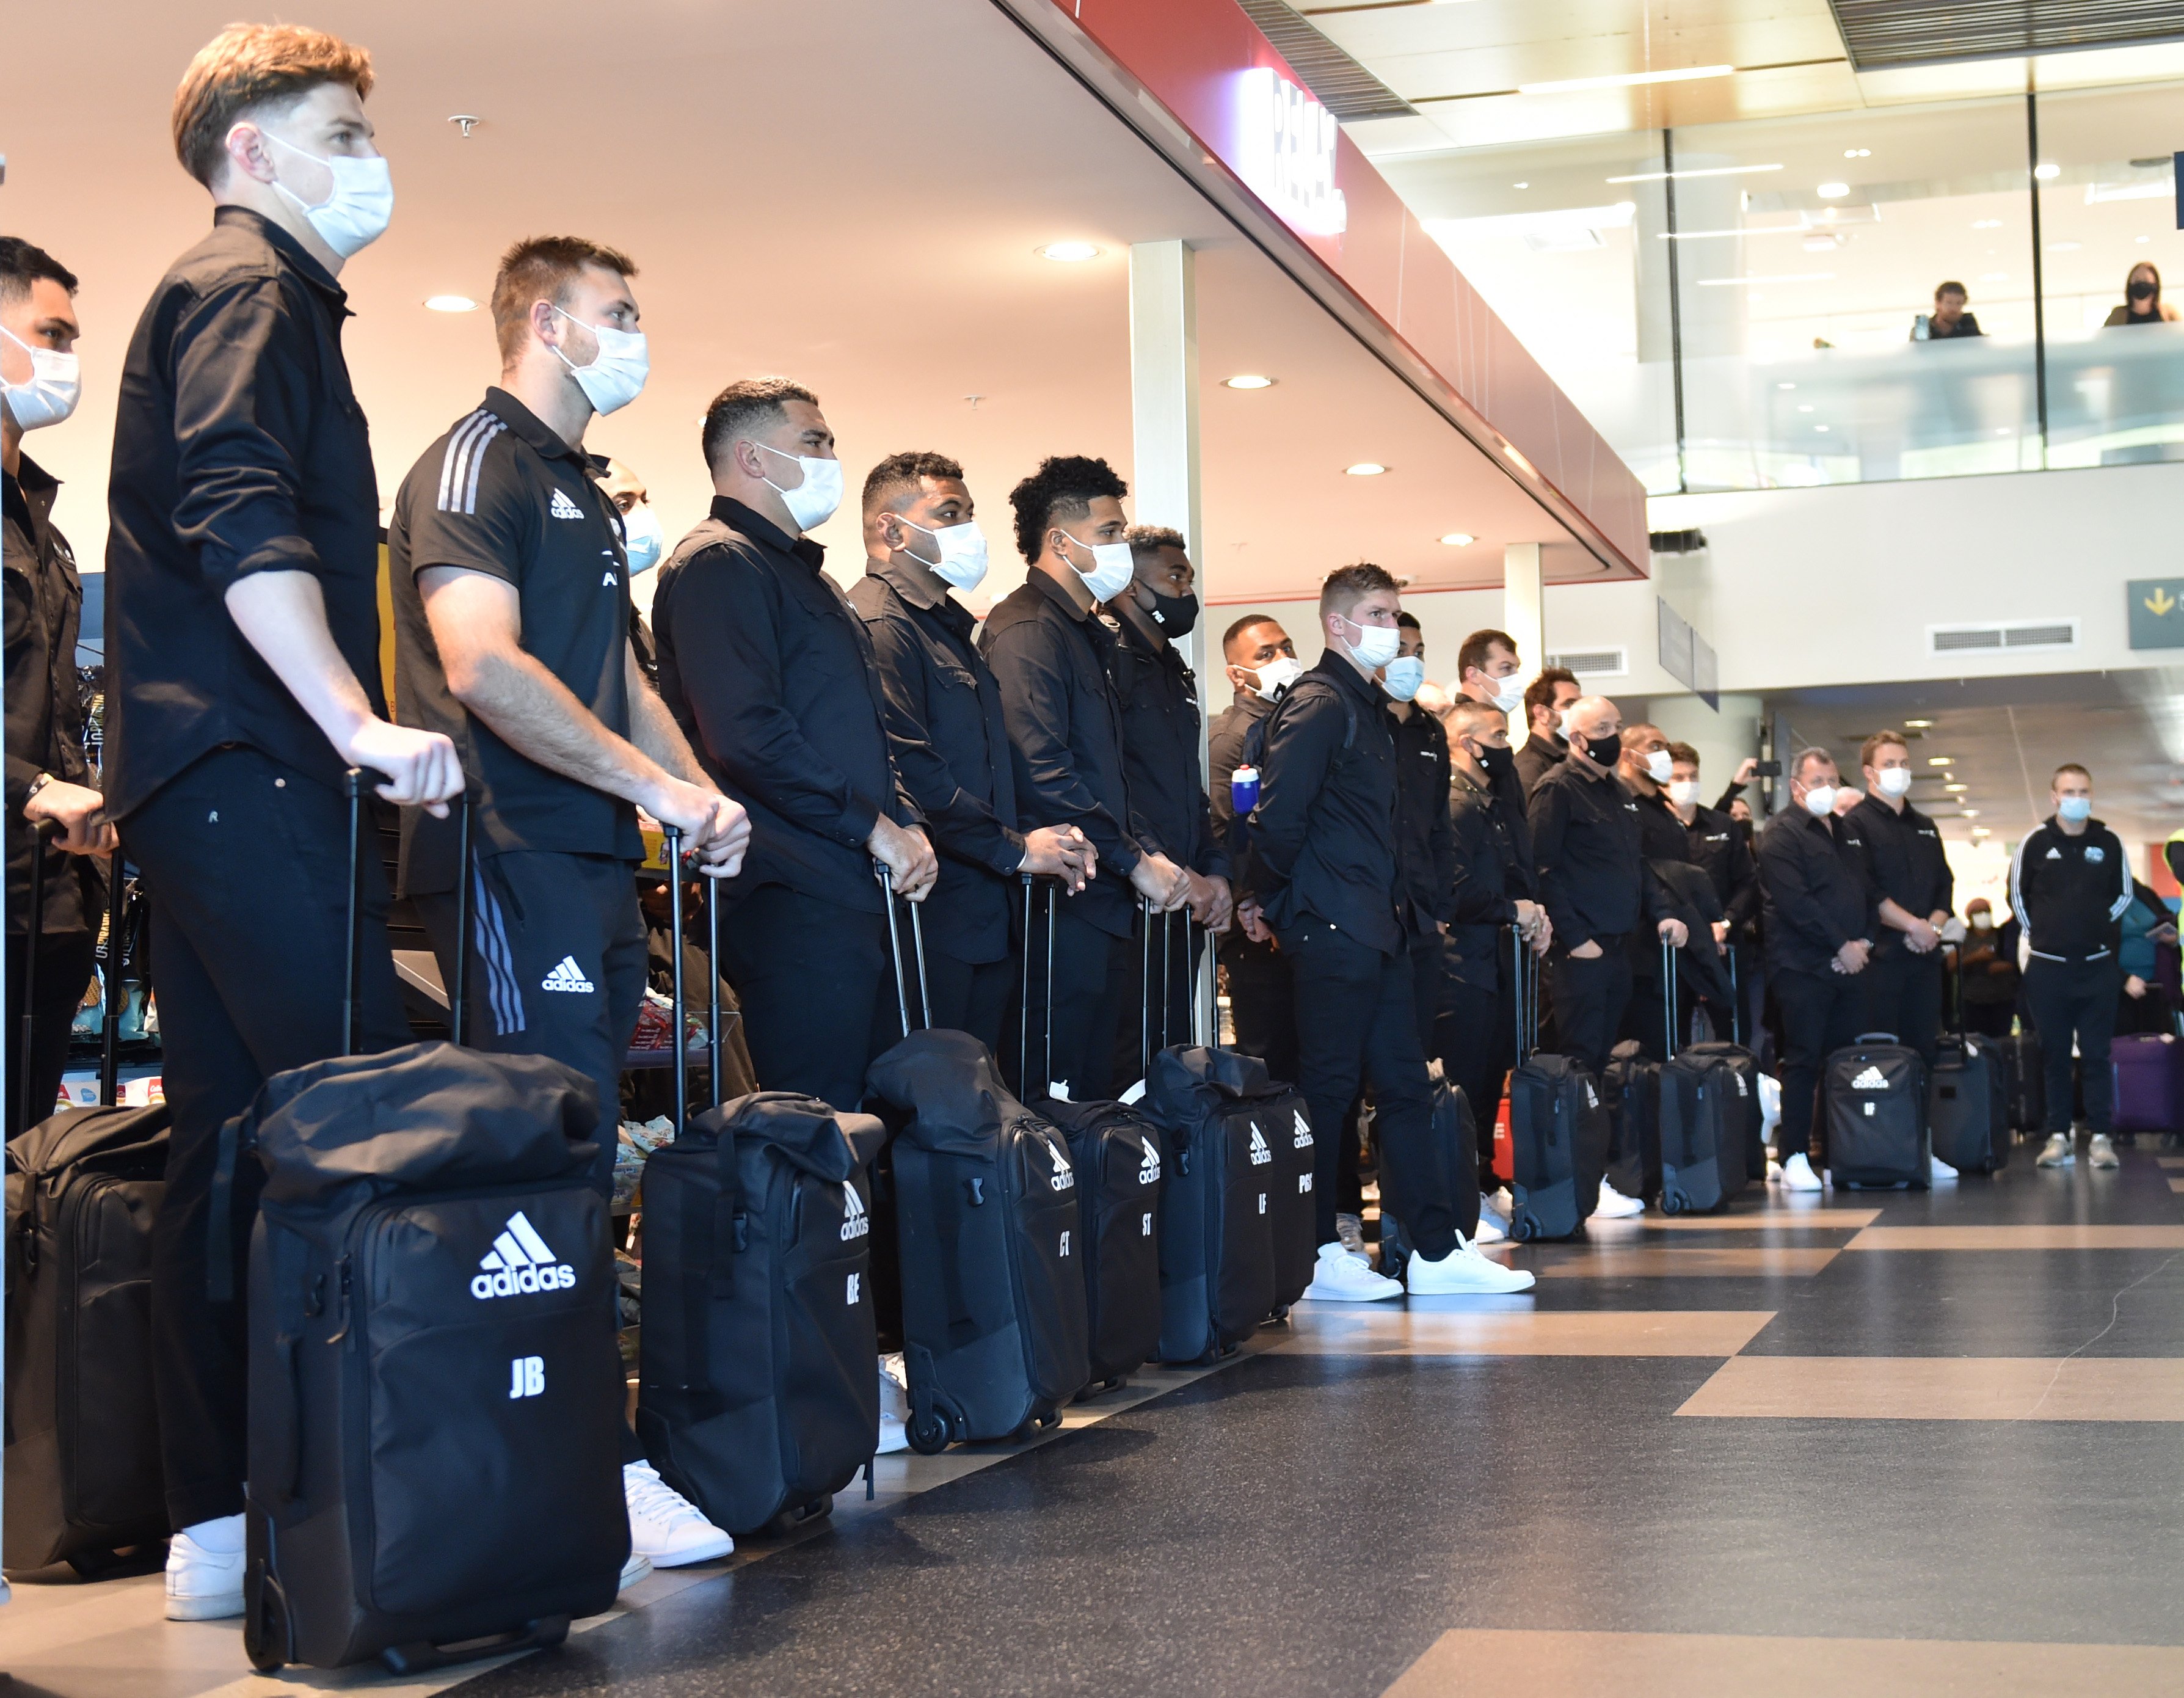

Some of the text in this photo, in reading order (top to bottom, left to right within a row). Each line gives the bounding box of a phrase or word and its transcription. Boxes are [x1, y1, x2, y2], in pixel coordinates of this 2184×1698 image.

[542, 978, 594, 993] adidas
[1852, 1079, 1890, 1089] adidas
[1864, 1102, 1876, 1117] IF
[1250, 1147, 1272, 1166] adidas
[1259, 1193, 1267, 1215] LF
[840, 1214, 869, 1242] adidas
[1142, 1212, 1152, 1237] ST
[1059, 1230, 1070, 1258] CT
[470, 1263, 576, 1300] adidas
[846, 1272, 860, 1305] BE
[509, 1355, 545, 1399] JB
